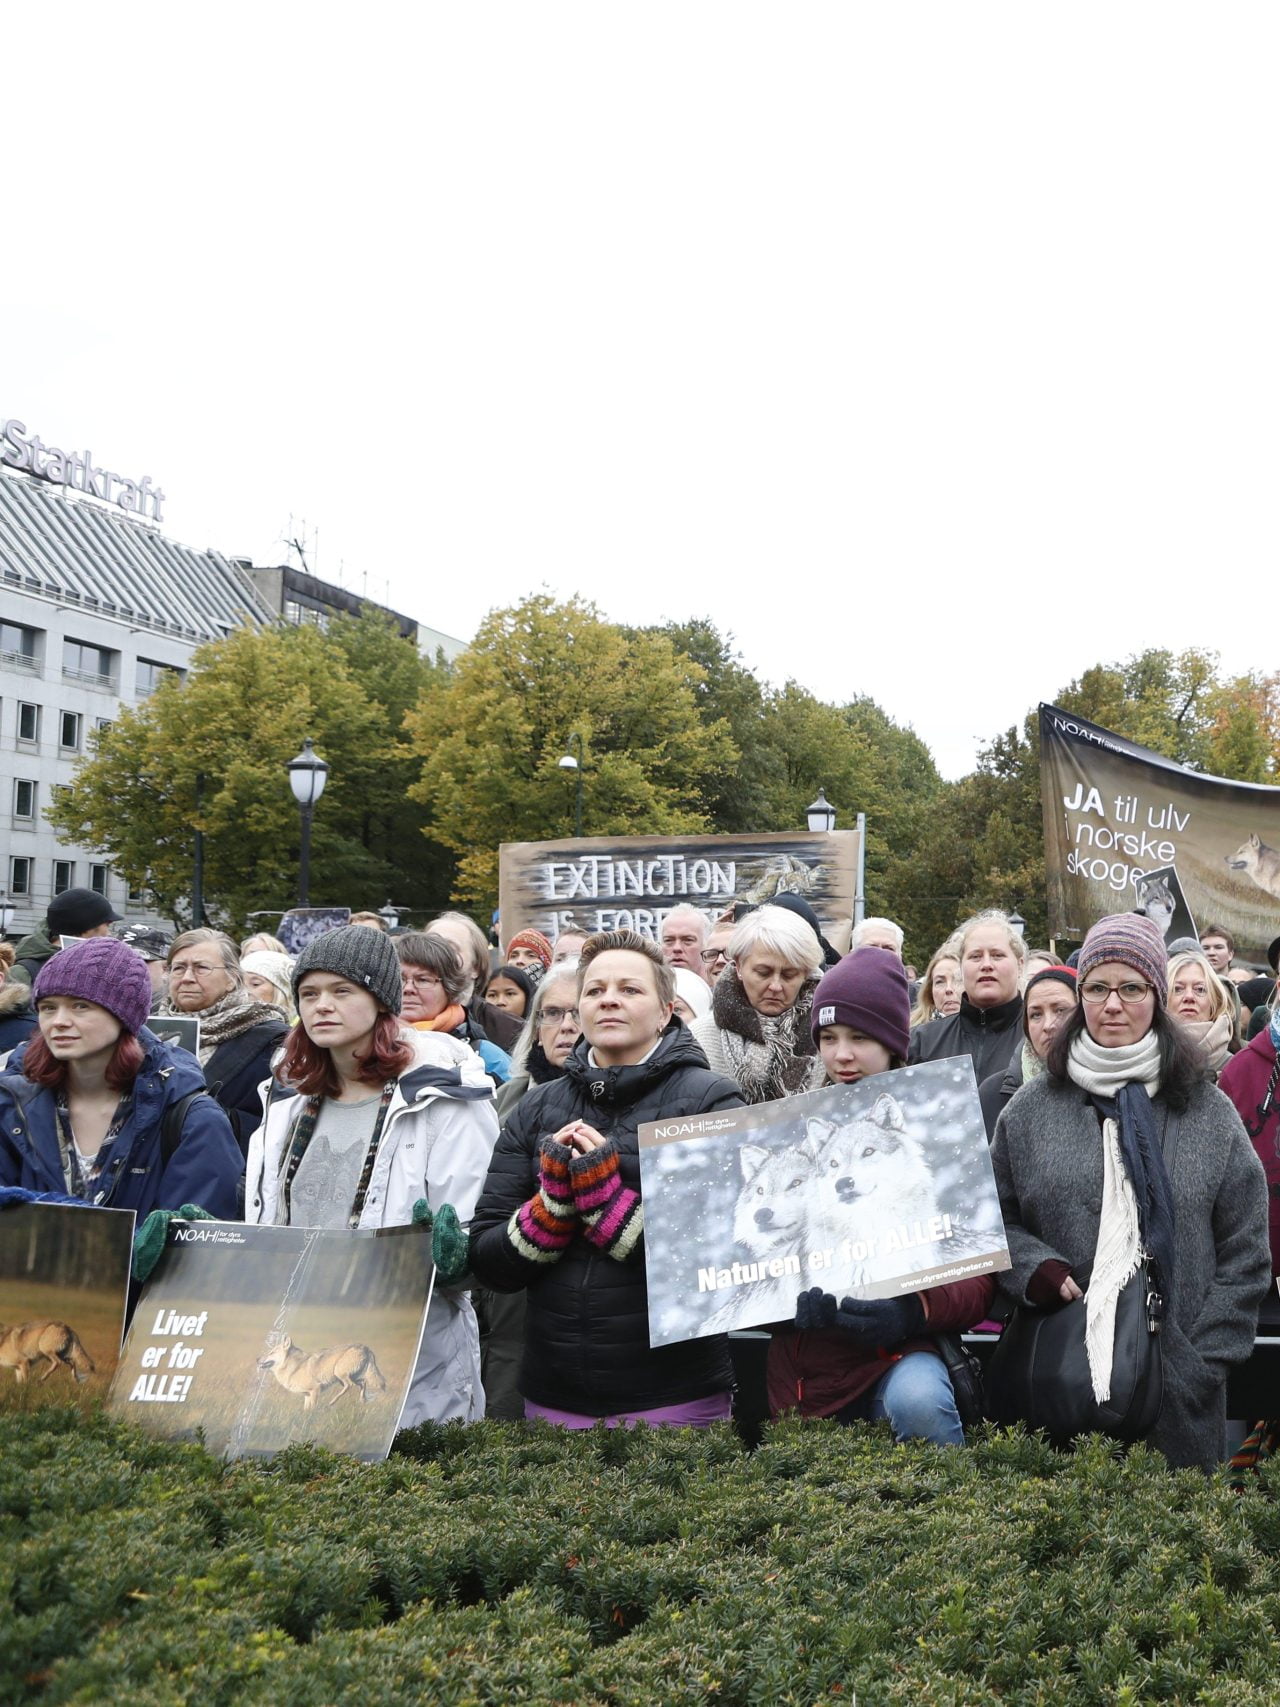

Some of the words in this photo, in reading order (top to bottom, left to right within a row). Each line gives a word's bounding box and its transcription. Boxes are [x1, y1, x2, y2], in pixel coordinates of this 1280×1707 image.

[4, 419, 166, 523] Statkraft
[1054, 717, 1102, 745] NOAH
[1064, 783, 1105, 817] JA
[1114, 795, 1137, 824] til
[1148, 803, 1191, 832] ulv
[1064, 813, 1070, 840] i
[1076, 823, 1176, 862] norske
[546, 855, 736, 900] EXTINCTION
[551, 910, 575, 943] IS
[654, 1122, 702, 1139] NOAH
[174, 1229, 217, 1242] NOAH
[697, 1254, 801, 1293] Naturen
[808, 1246, 835, 1270] er
[843, 1238, 880, 1264] for
[884, 1213, 953, 1253] ALLE!
[151, 1309, 208, 1336] Livet
[141, 1347, 167, 1368] er
[168, 1342, 204, 1369] for
[129, 1374, 194, 1402] ALLE!
